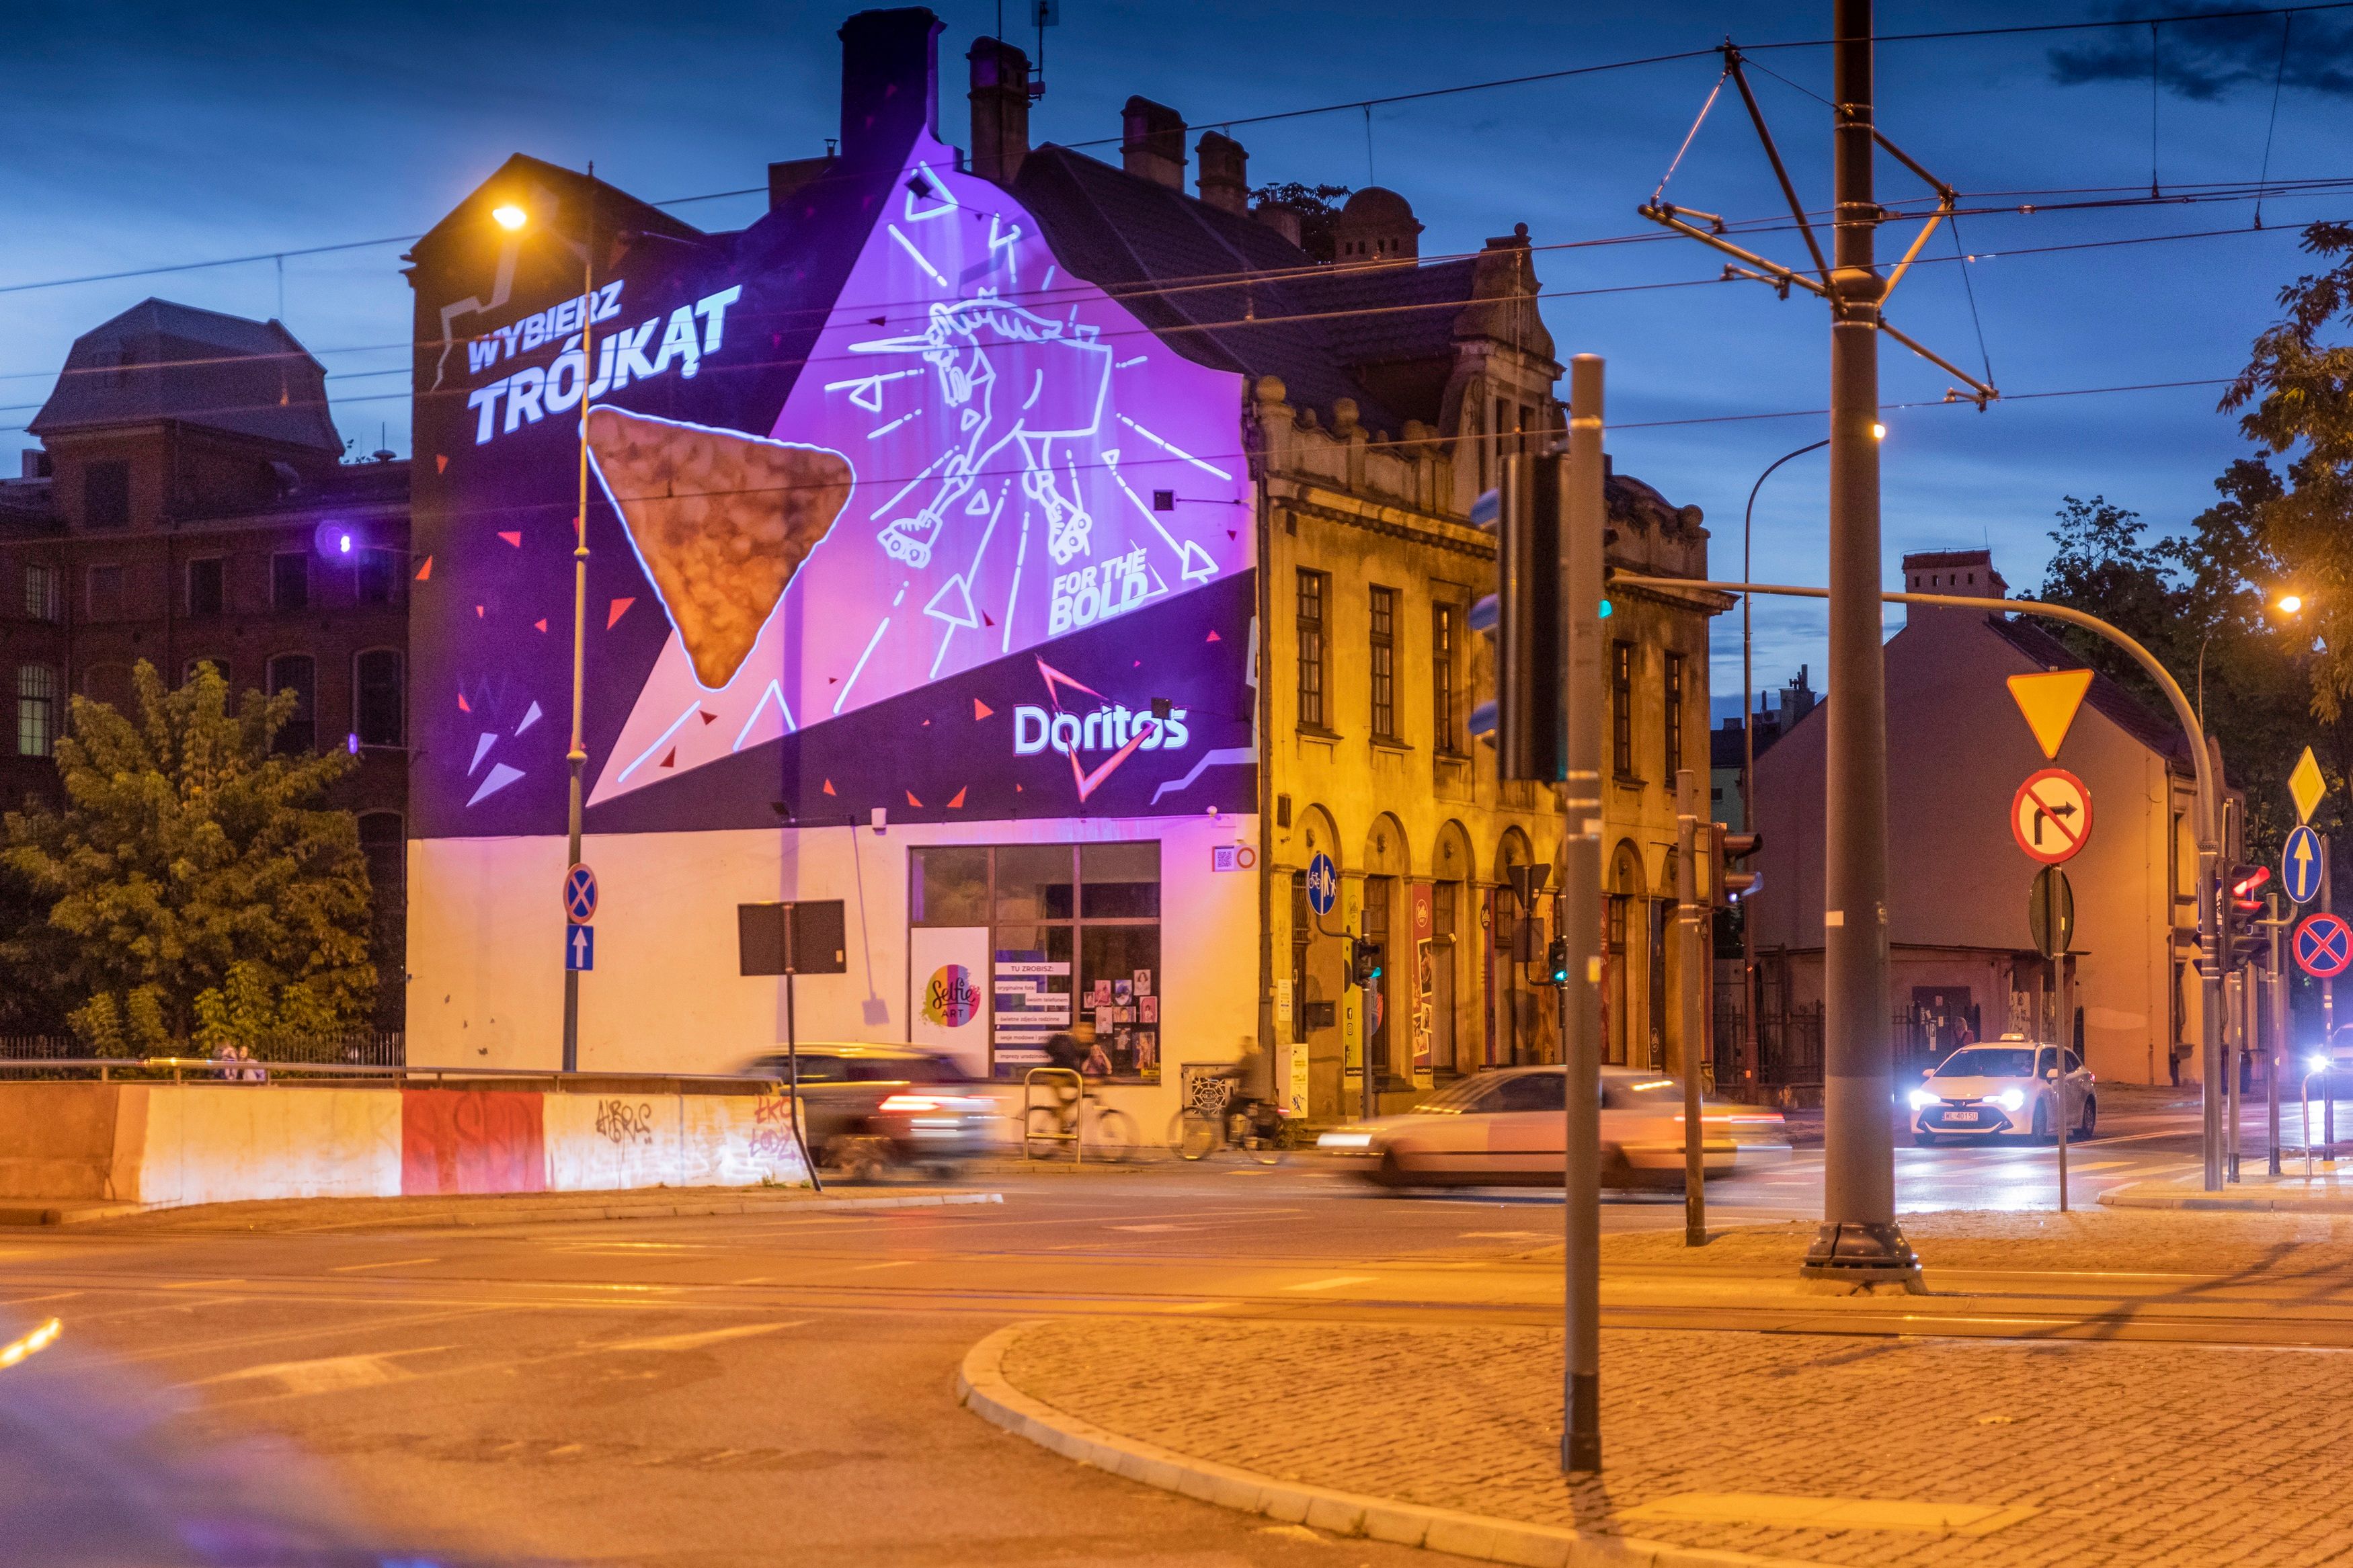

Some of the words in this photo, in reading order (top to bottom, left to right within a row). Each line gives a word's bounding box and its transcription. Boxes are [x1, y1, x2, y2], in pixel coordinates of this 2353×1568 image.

[468, 279, 624, 374] WYBIERZ
[467, 284, 743, 446] TRÓJKĄT
[1052, 566, 1098, 600] FOR
[1101, 548, 1147, 583] THE
[1048, 571, 1148, 635] BOLD
[1014, 700, 1189, 757] Doritos
[932, 977, 976, 1009] Selfie
[941, 1009, 964, 1018] ART
